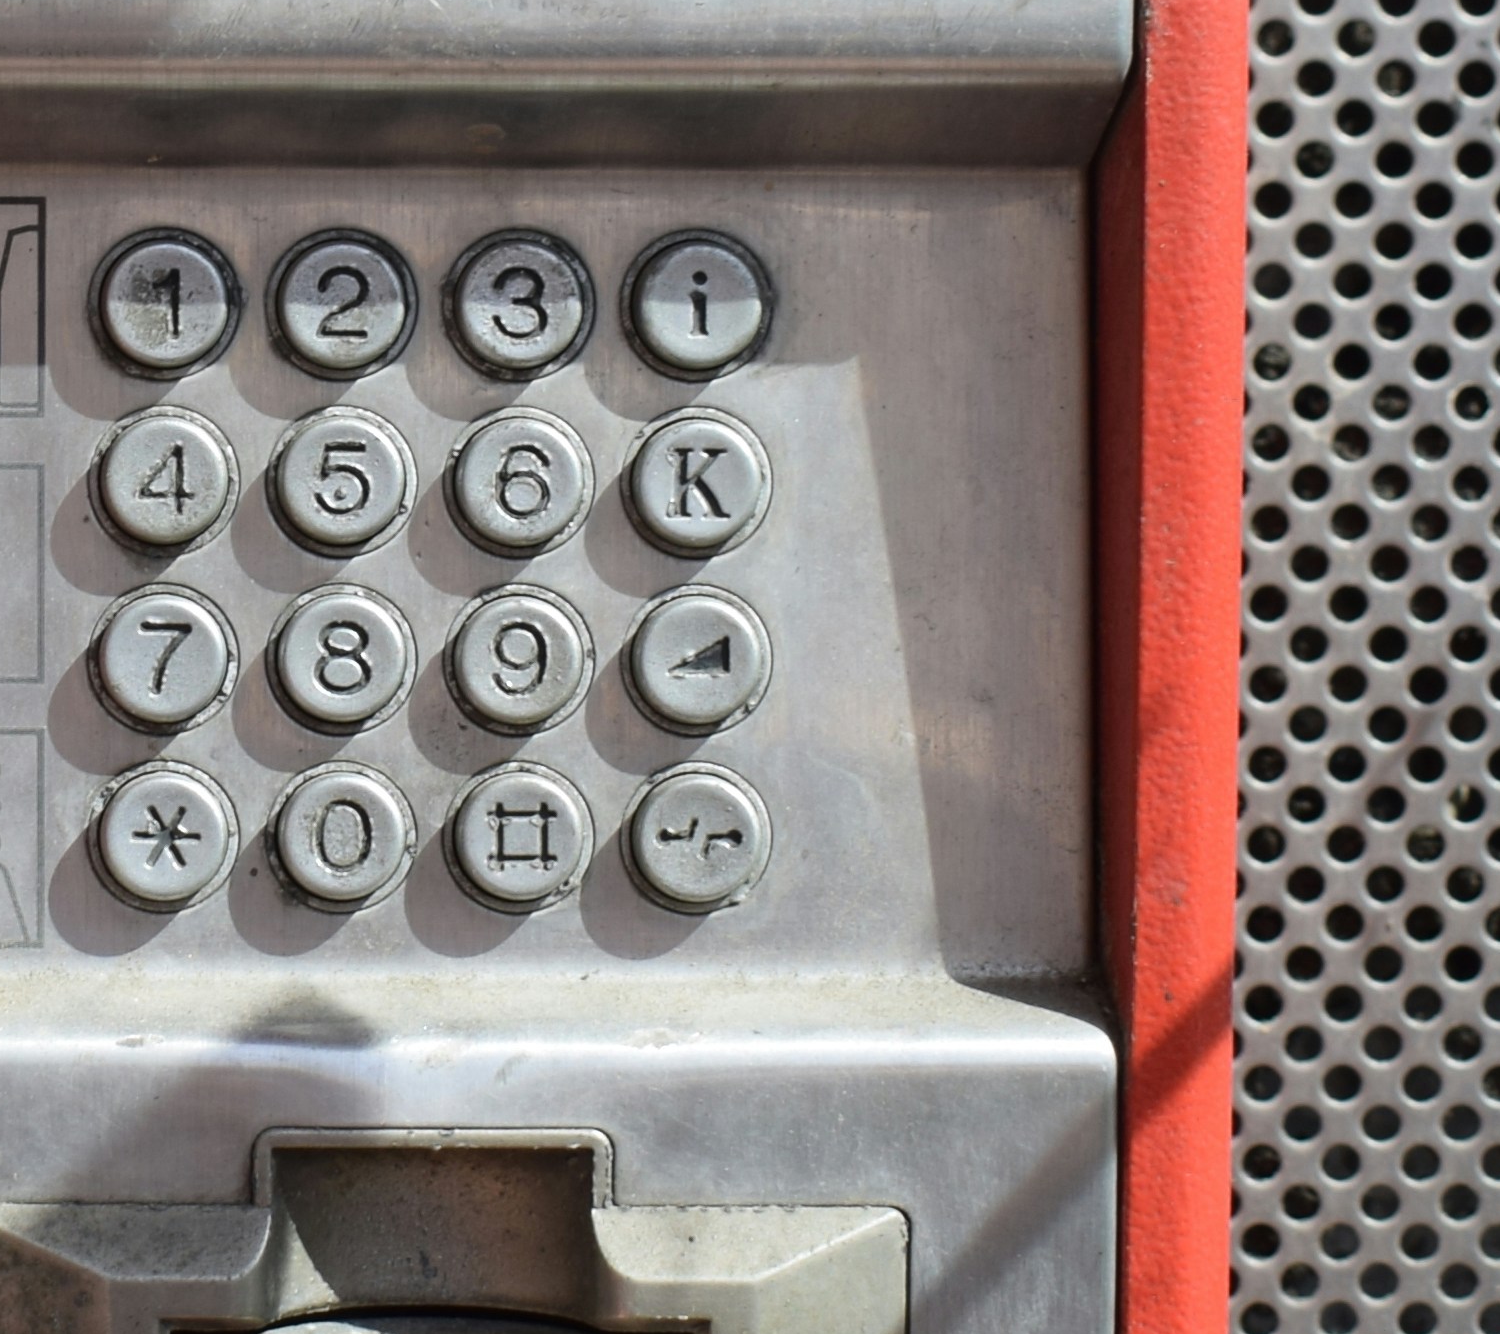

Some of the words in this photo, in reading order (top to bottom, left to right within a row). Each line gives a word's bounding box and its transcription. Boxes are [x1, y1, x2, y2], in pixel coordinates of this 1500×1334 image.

[149, 266, 184, 339] 1
[316, 266, 370, 339] 2
[490, 266, 550, 339] 3
[140, 444, 196, 516] 4
[313, 440, 372, 514] 5
[494, 443, 552, 520] 6
[664, 447, 732, 519] K
[138, 621, 194, 697] 7
[313, 620, 372, 695] 8
[490, 621, 548, 696] 9
[312, 798, 372, 873] 0
